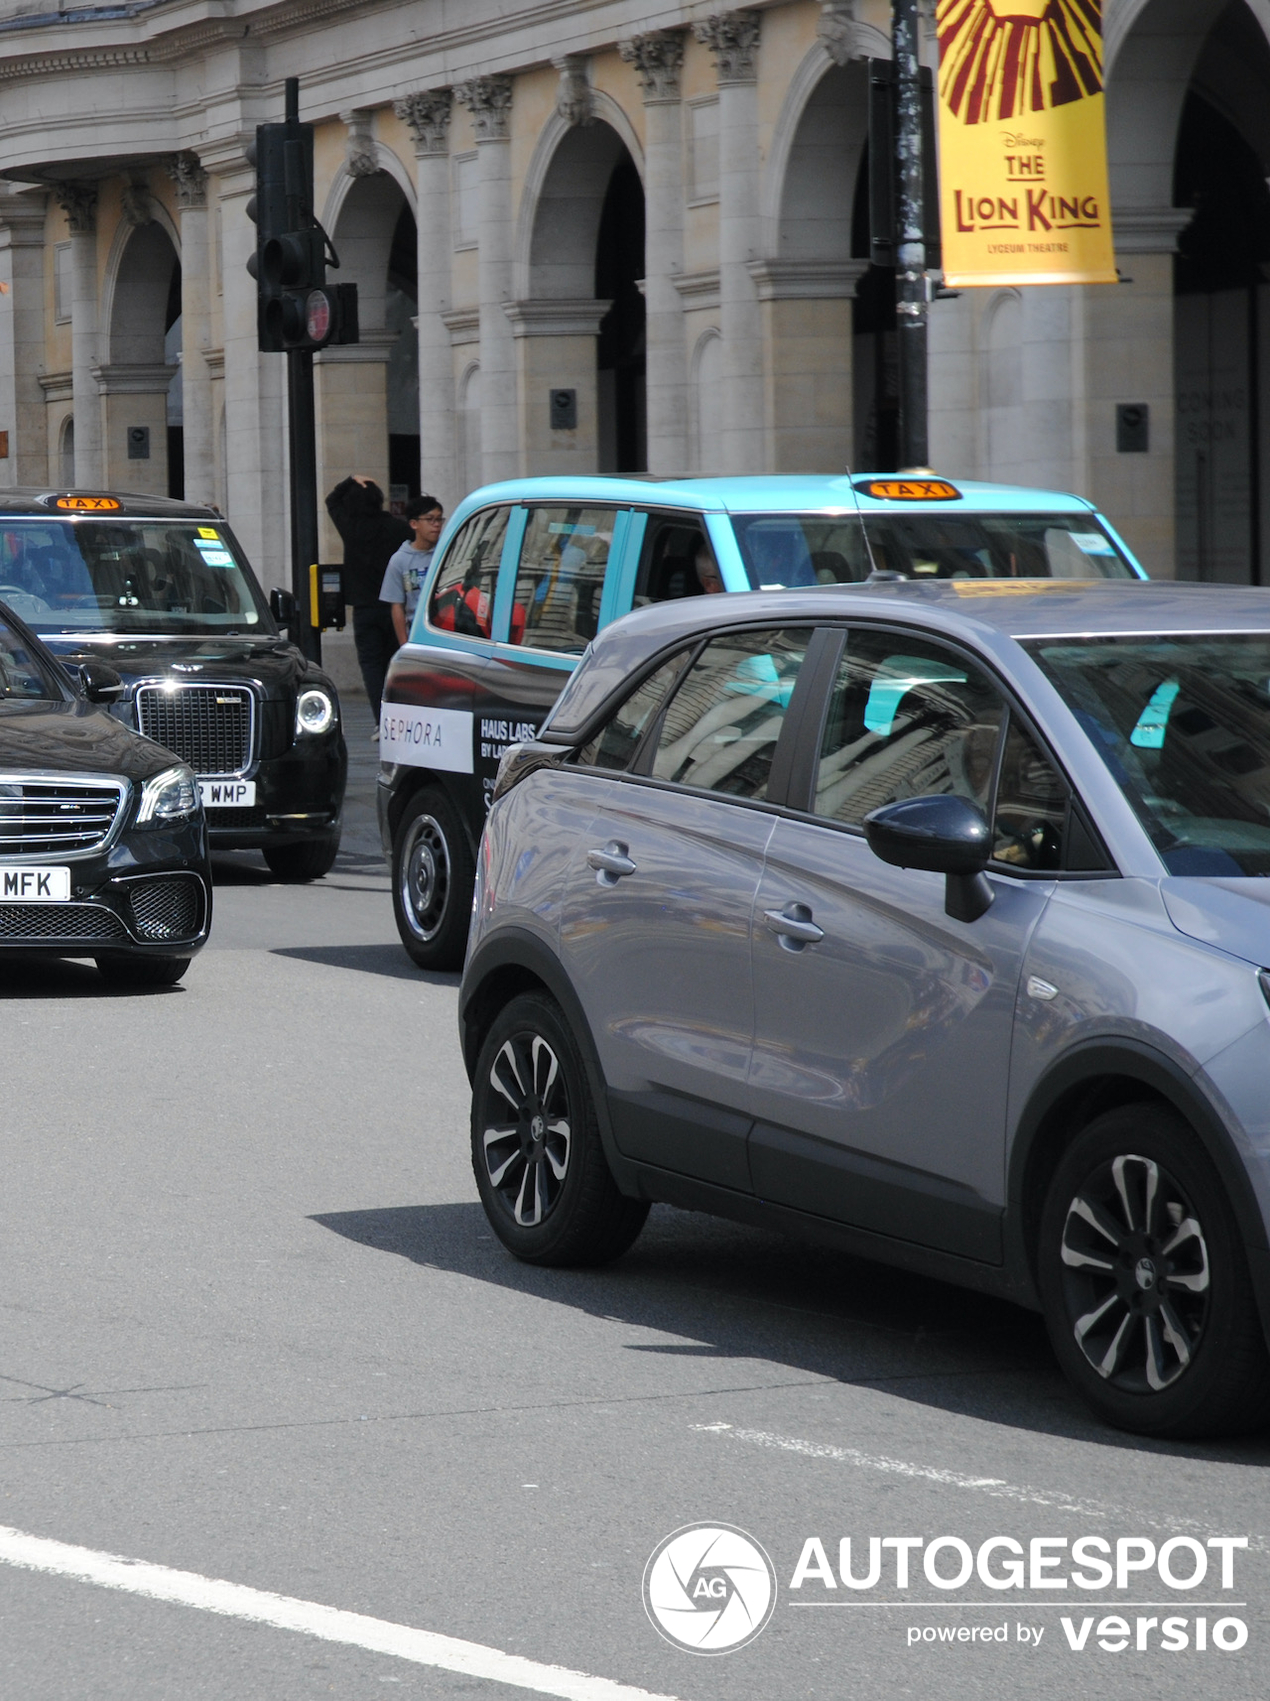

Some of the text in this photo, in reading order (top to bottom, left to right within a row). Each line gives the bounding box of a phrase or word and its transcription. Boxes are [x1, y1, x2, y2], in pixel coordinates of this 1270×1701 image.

[1000, 131, 1045, 150] Disney
[1004, 156, 1045, 175] THE
[954, 188, 1099, 232] LION KING
[988, 243, 1069, 254] LYCEUM THEATRE
[877, 483, 950, 496] TAXI
[61, 499, 114, 508] TAXI
[384, 717, 442, 747] SEPHORA
[481, 719, 536, 742] HAUS LABS
[481, 743, 491, 757] BY
[211, 785, 247, 803] WMP
[4, 872, 51, 896] MFK
